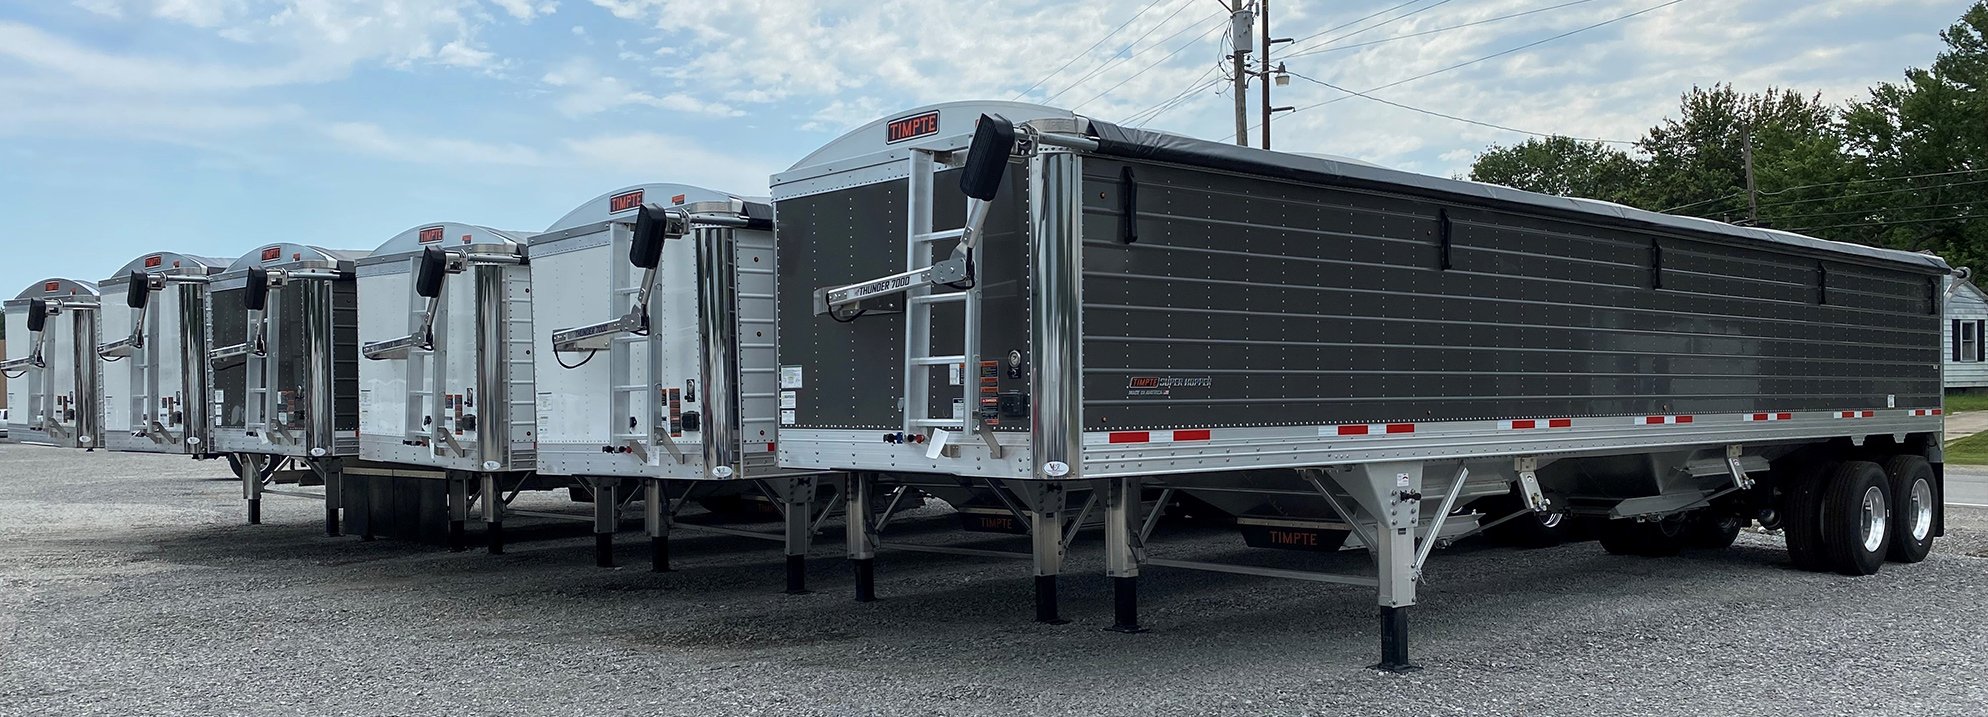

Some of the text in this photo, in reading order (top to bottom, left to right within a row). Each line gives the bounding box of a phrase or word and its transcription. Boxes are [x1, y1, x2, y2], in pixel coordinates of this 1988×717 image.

[890, 115, 936, 140] TIMPTE
[611, 192, 642, 211] TIMPTE
[859, 276, 910, 295] THUNDER 7000
[1132, 377, 1212, 387] TIMPTE SUPER HOPPER
[980, 517, 1013, 529] TIMPTE
[1269, 530, 1318, 546] TIMPTE
